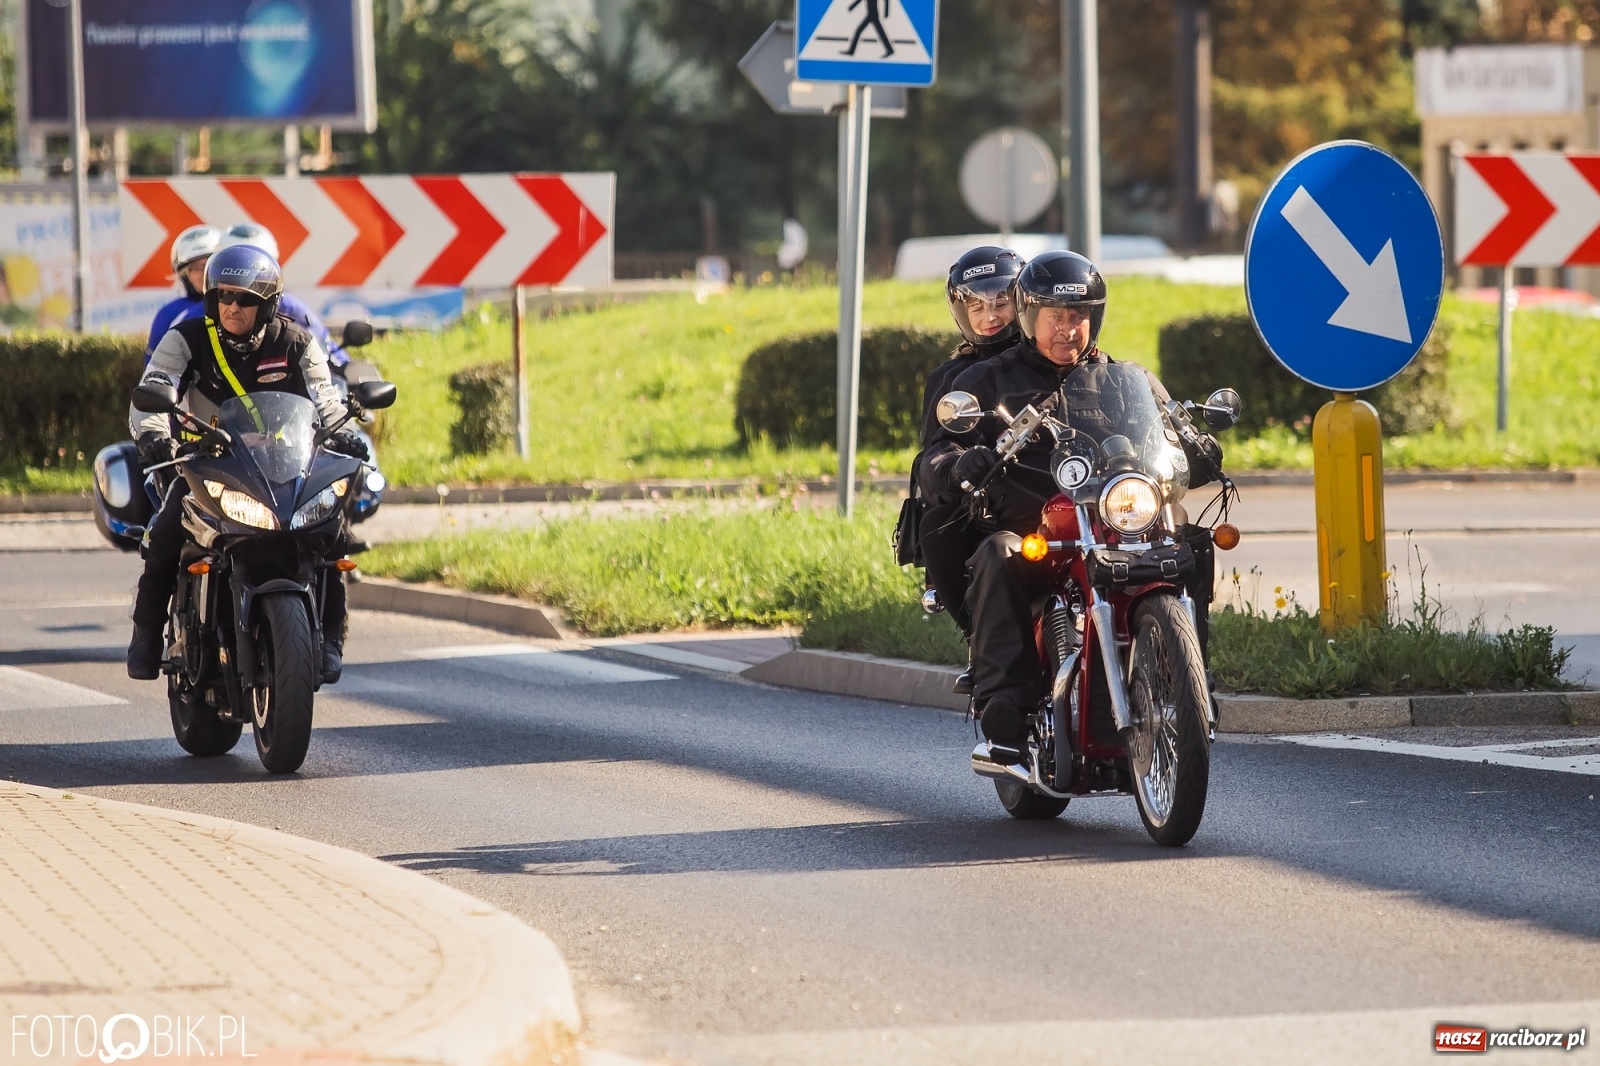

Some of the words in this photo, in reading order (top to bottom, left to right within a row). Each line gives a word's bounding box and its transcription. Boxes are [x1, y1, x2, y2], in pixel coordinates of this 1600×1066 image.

[221, 267, 250, 276] HJC
[964, 265, 993, 278] MDS
[1055, 285, 1085, 294] MDS
